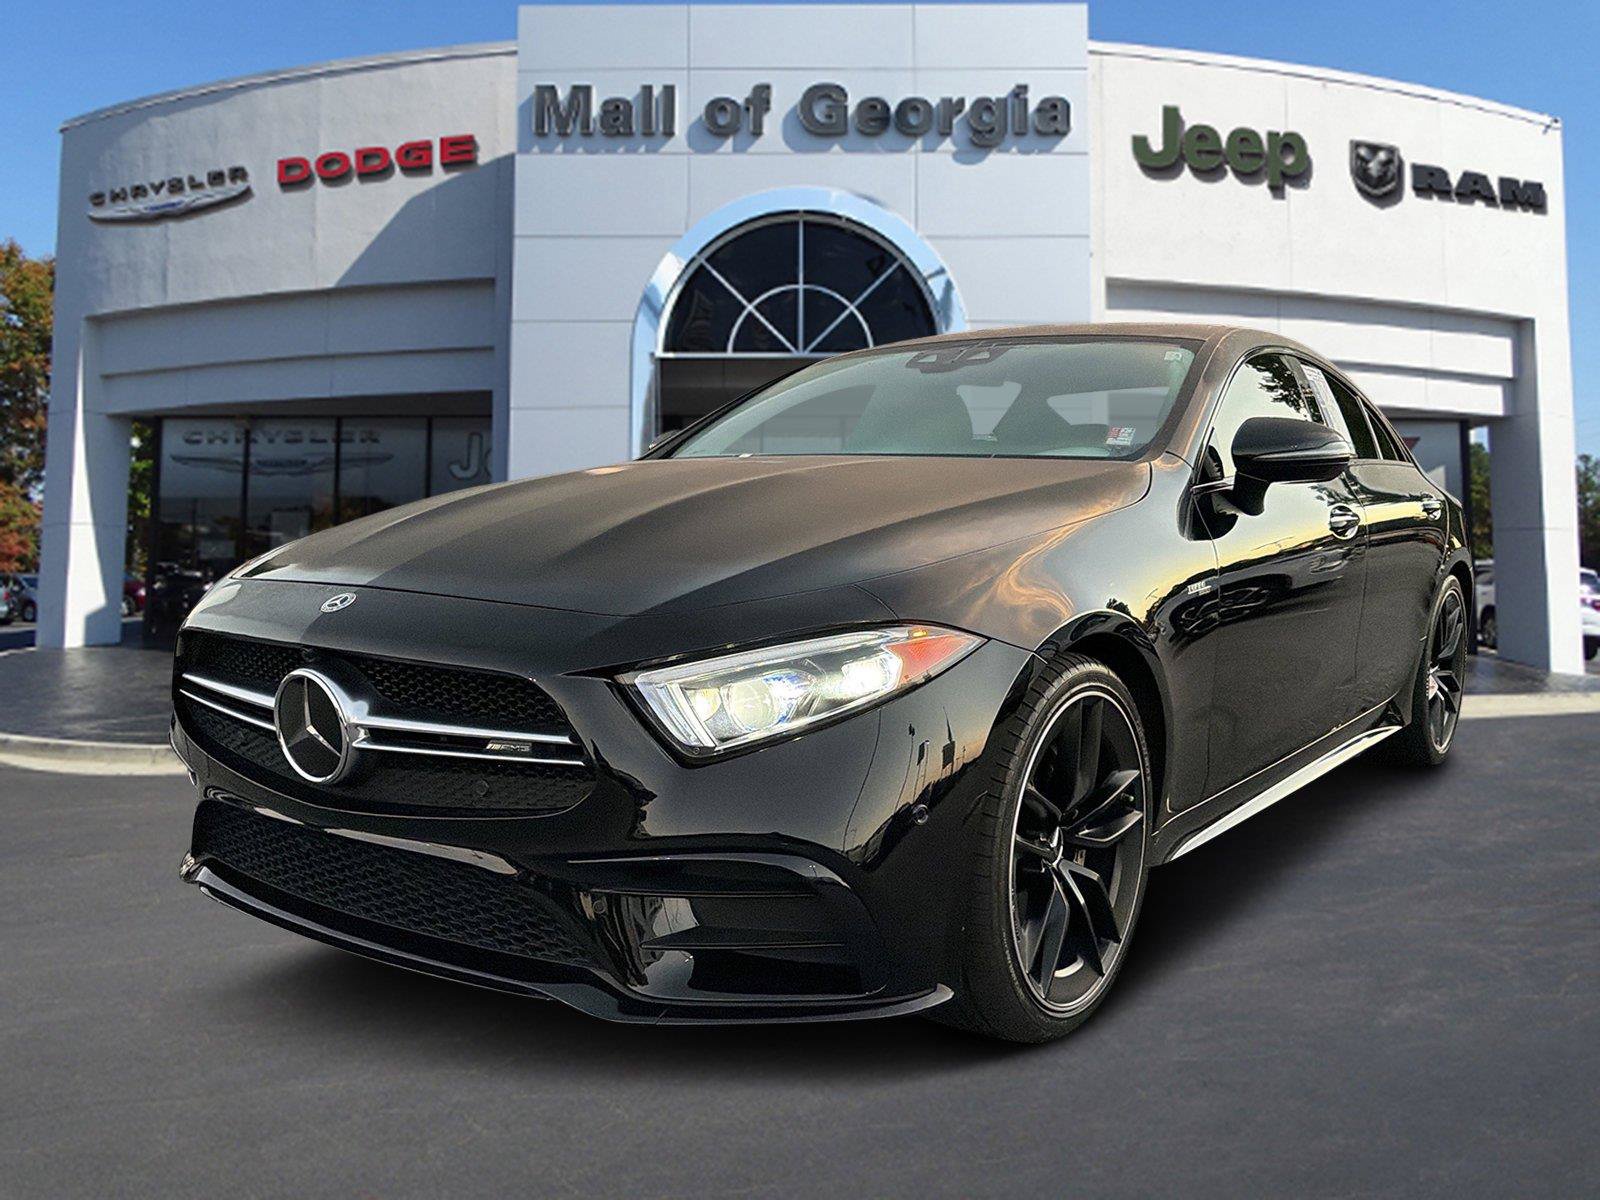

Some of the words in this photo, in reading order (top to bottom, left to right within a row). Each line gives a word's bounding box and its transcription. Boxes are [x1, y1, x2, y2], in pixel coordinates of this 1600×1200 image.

[533, 84, 676, 137] Mall
[704, 83, 772, 138] of
[800, 82, 1071, 148] Georgia
[277, 134, 477, 189] DODGE
[1131, 104, 1310, 188] Jeep
[89, 165, 249, 207] CHRYSLER
[1411, 163, 1546, 212] RAM
[182, 428, 381, 444] CHRYSLER
[449, 431, 492, 480] J
